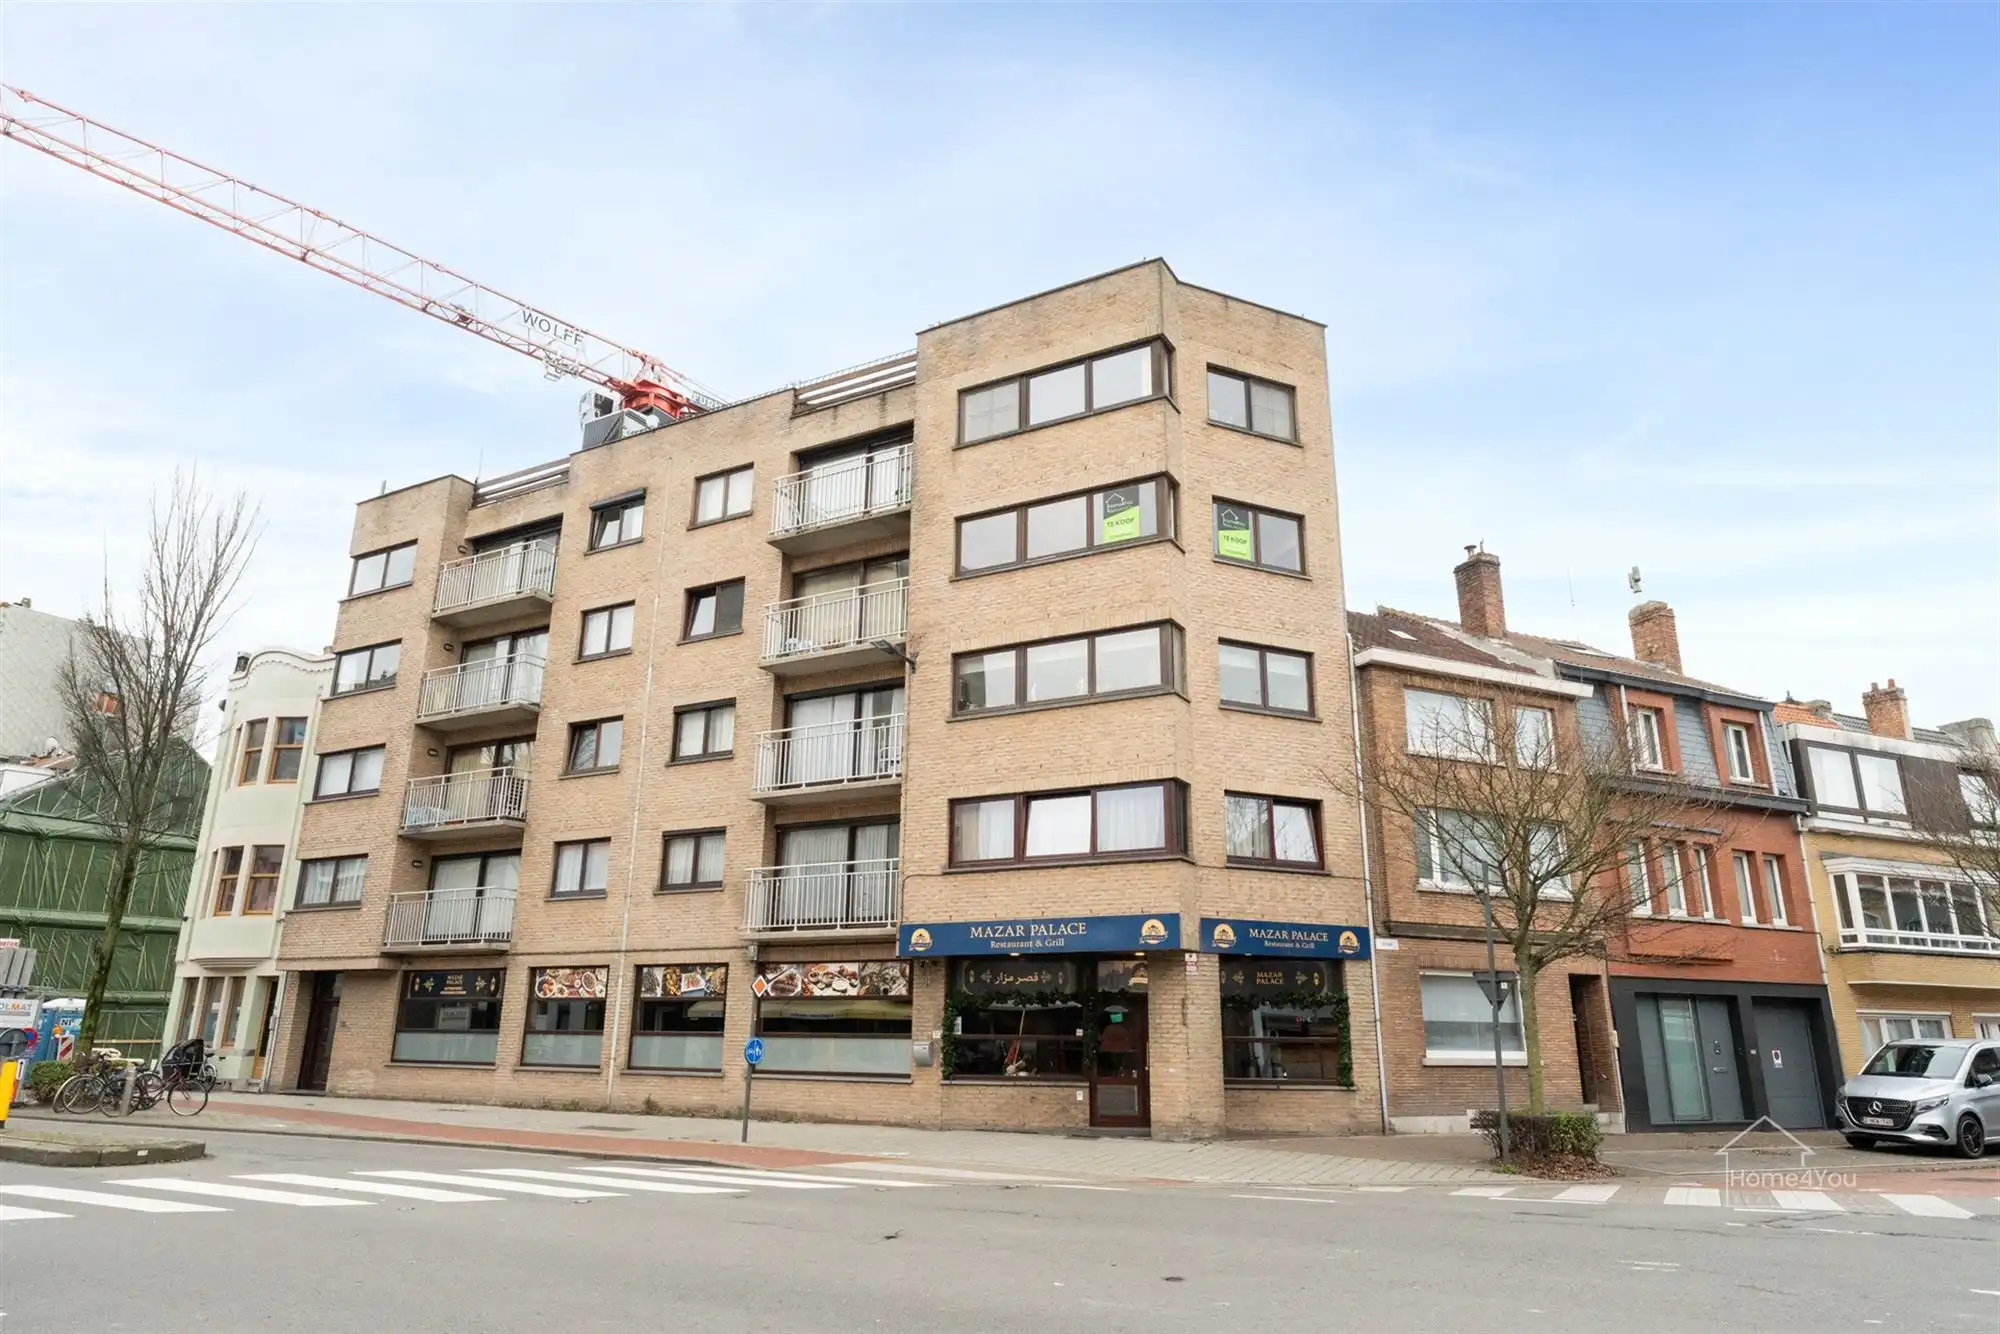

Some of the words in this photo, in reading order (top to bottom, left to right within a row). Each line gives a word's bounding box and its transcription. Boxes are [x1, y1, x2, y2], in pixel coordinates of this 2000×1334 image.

[522, 309, 584, 345] WOLFF
[970, 925, 1026, 938] MAZAR
[1030, 922, 1088, 936] PALACE
[1249, 928, 1289, 940] MAZAR
[1291, 931, 1329, 942] PALACE
[990, 939, 1033, 949] Restaurant
[1035, 940, 1043, 948] &
[1045, 938, 1065, 948] Grill
[1264, 940, 1295, 949] Restaurant
[1302, 941, 1315, 949] Grill
[994, 972, 1014, 985] مزار
[1015, 972, 1039, 985] قصر
[1256, 971, 1284, 979] MAZAR
